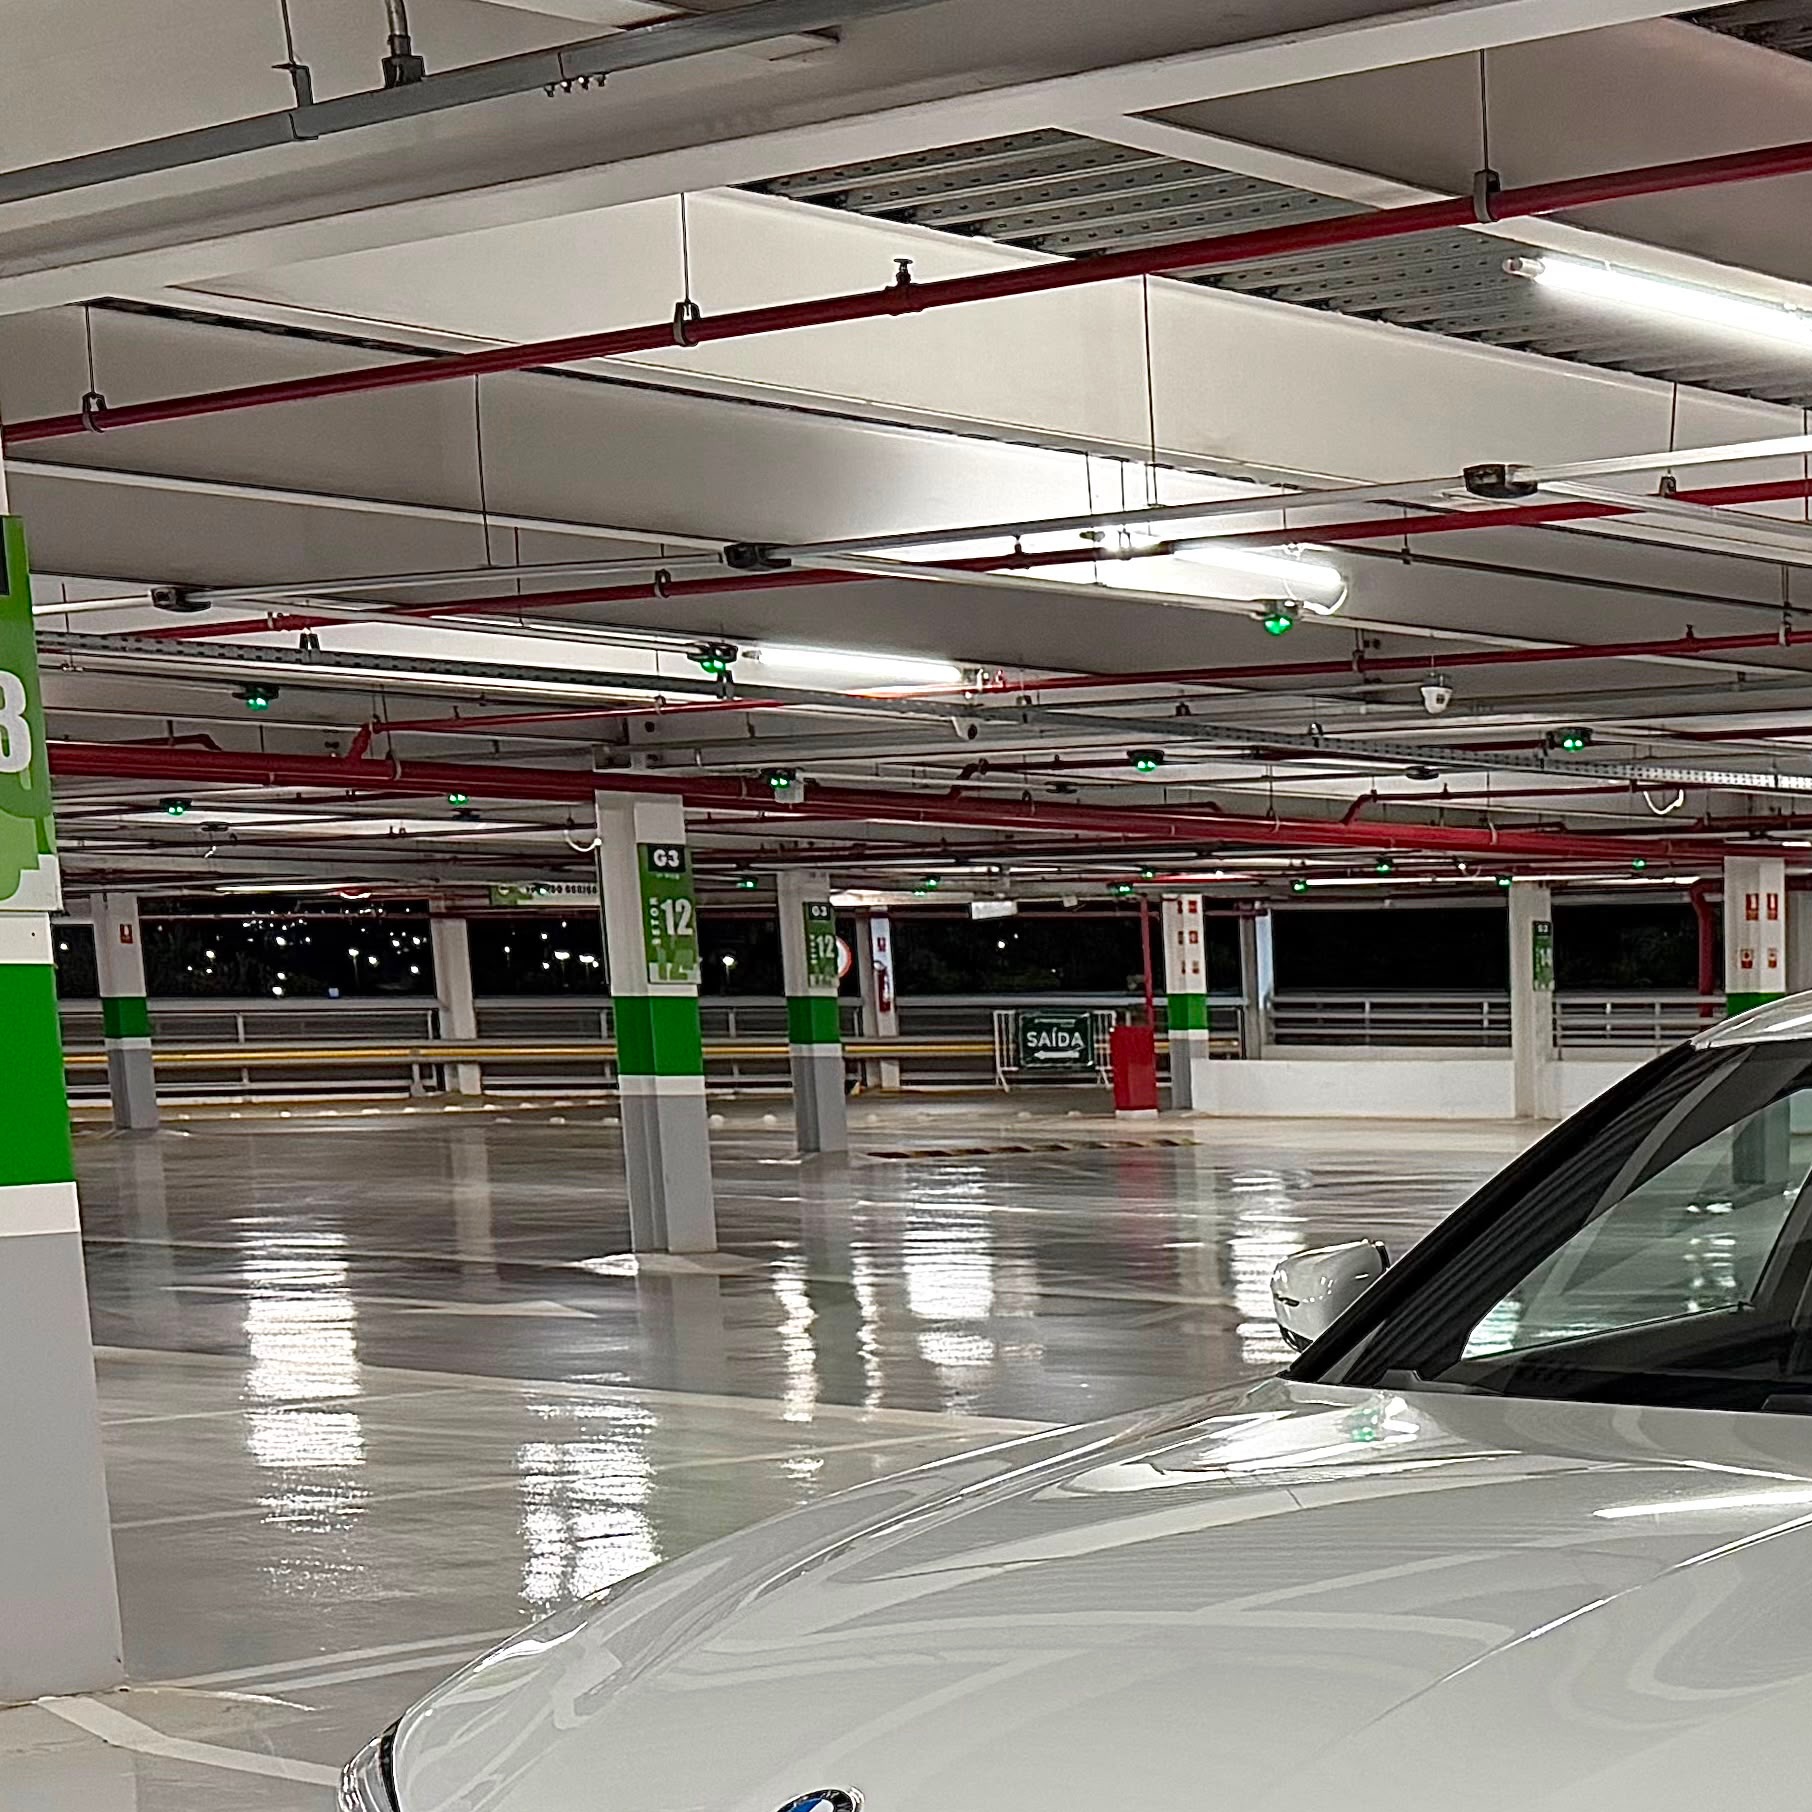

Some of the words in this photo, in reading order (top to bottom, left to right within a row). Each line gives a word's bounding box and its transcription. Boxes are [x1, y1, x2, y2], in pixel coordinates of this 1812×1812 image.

[653, 849, 680, 868] G3
[660, 898, 693, 936] 12
[816, 934, 835, 958] 12
[1026, 1027, 1085, 1048] SAÍDA
